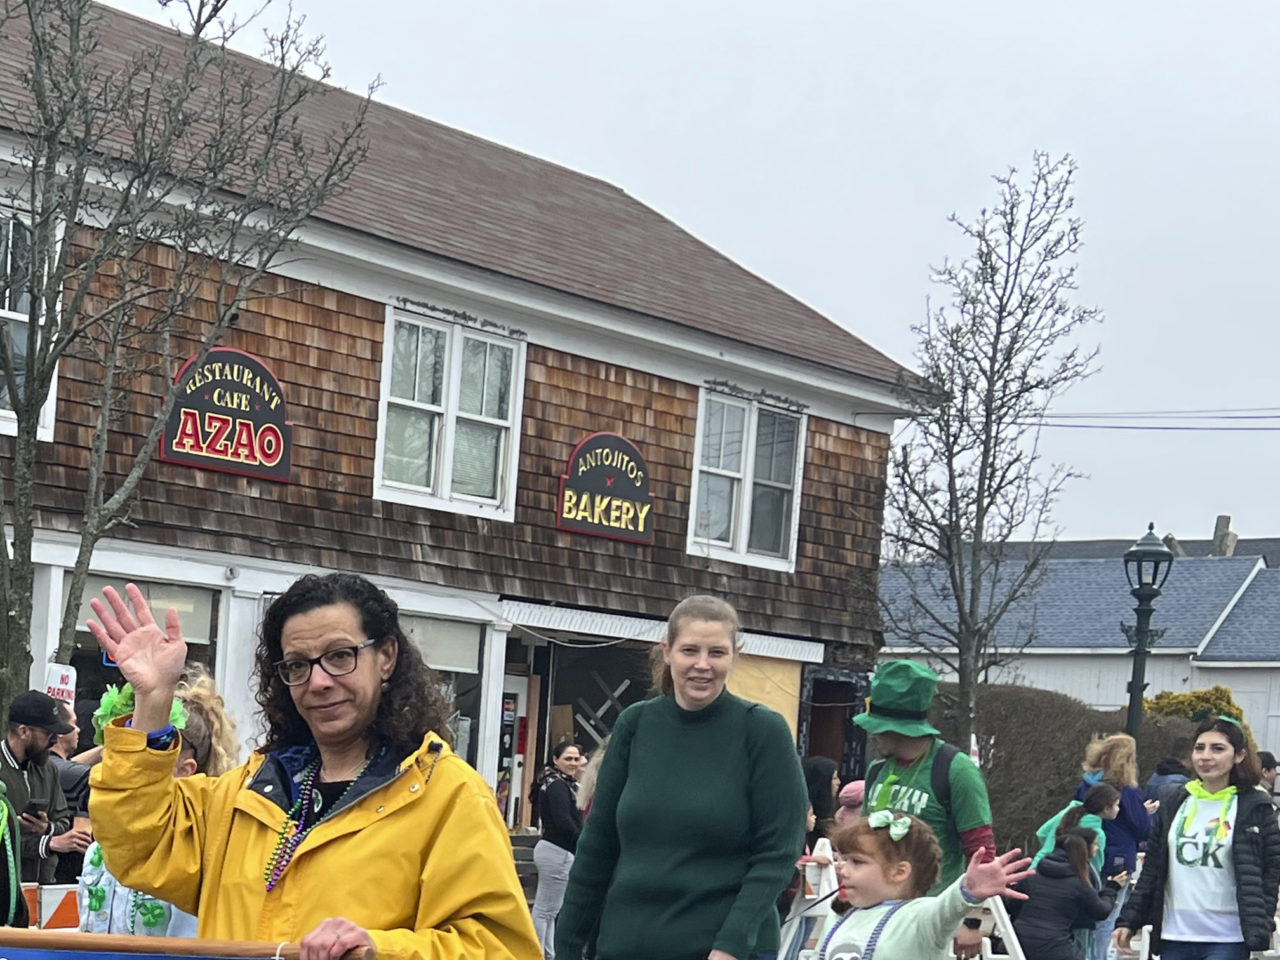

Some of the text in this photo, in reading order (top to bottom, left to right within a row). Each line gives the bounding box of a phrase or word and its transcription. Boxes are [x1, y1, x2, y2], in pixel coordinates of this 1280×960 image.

[185, 362, 281, 411] RESTAURANT
[212, 388, 250, 412] CAFE
[172, 407, 284, 467] AZAO
[577, 447, 644, 487] ANTOJITOS
[562, 488, 651, 533] BAKERY
[59, 673, 70, 686] NO
